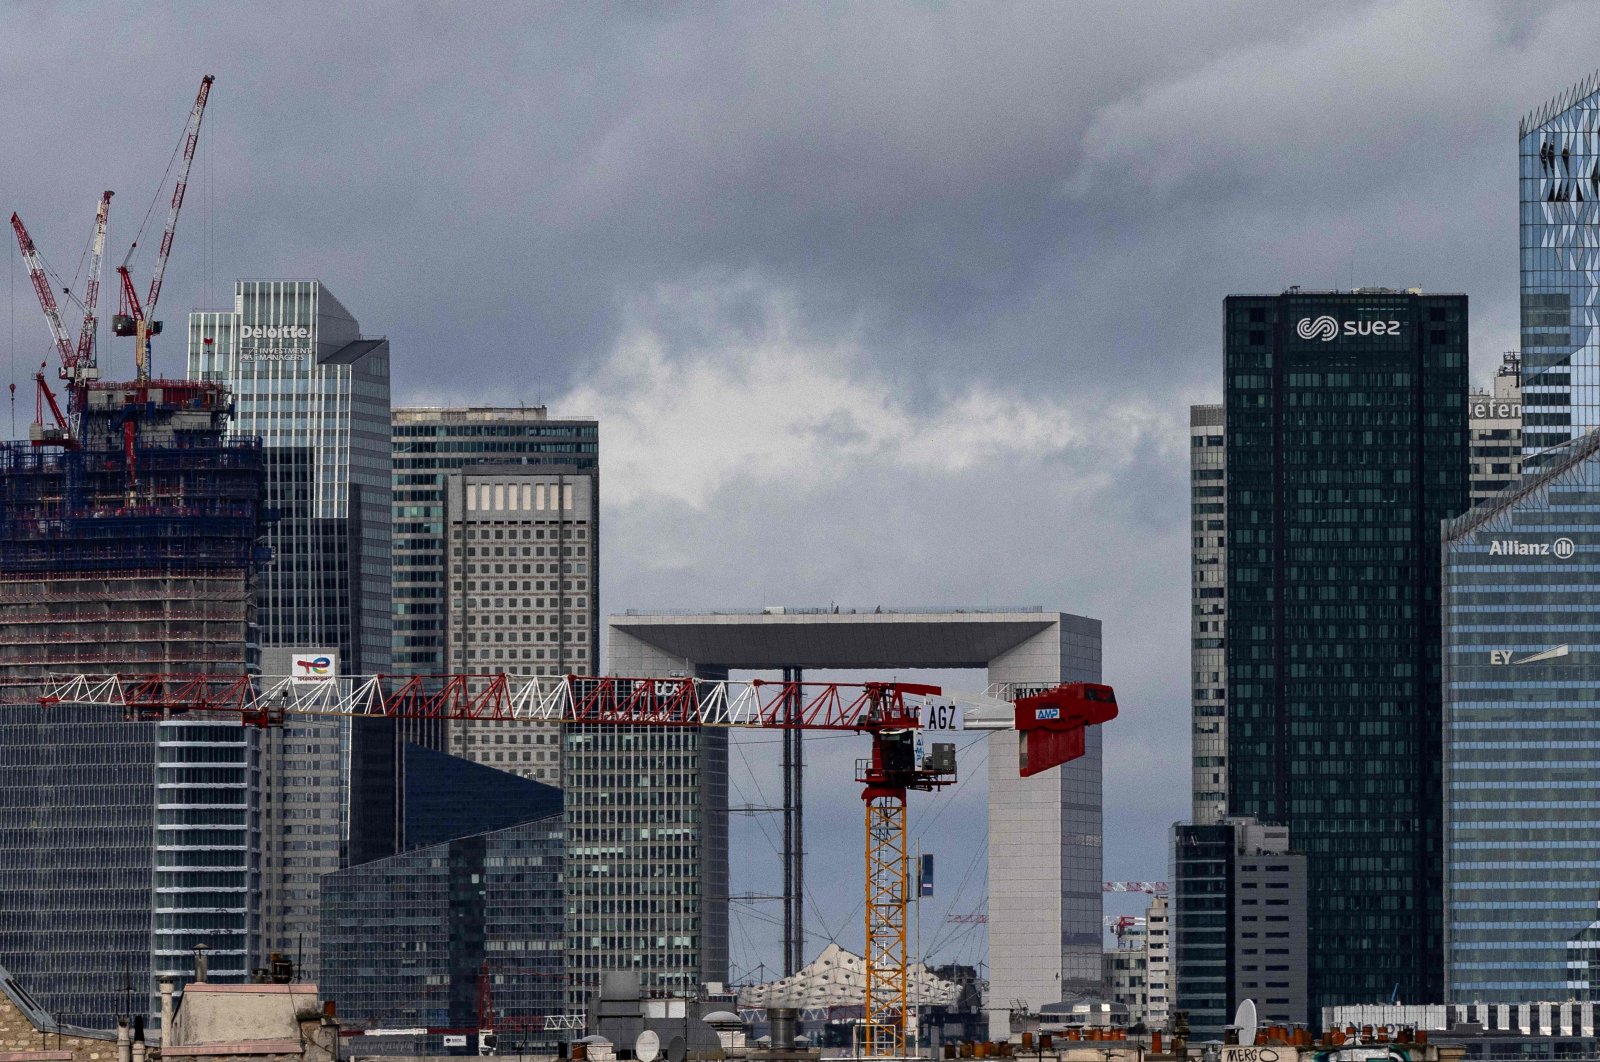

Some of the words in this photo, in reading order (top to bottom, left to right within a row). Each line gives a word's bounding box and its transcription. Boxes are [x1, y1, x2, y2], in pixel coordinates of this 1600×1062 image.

[241, 325, 312, 339] Deloitte.
[1343, 320, 1400, 335] suez
[1469, 399, 1521, 418] éfen
[1489, 540, 1550, 556] Allianz
[1491, 650, 1513, 665] EY
[928, 705, 956, 730] AGZ
[1037, 709, 1058, 719] AMP
